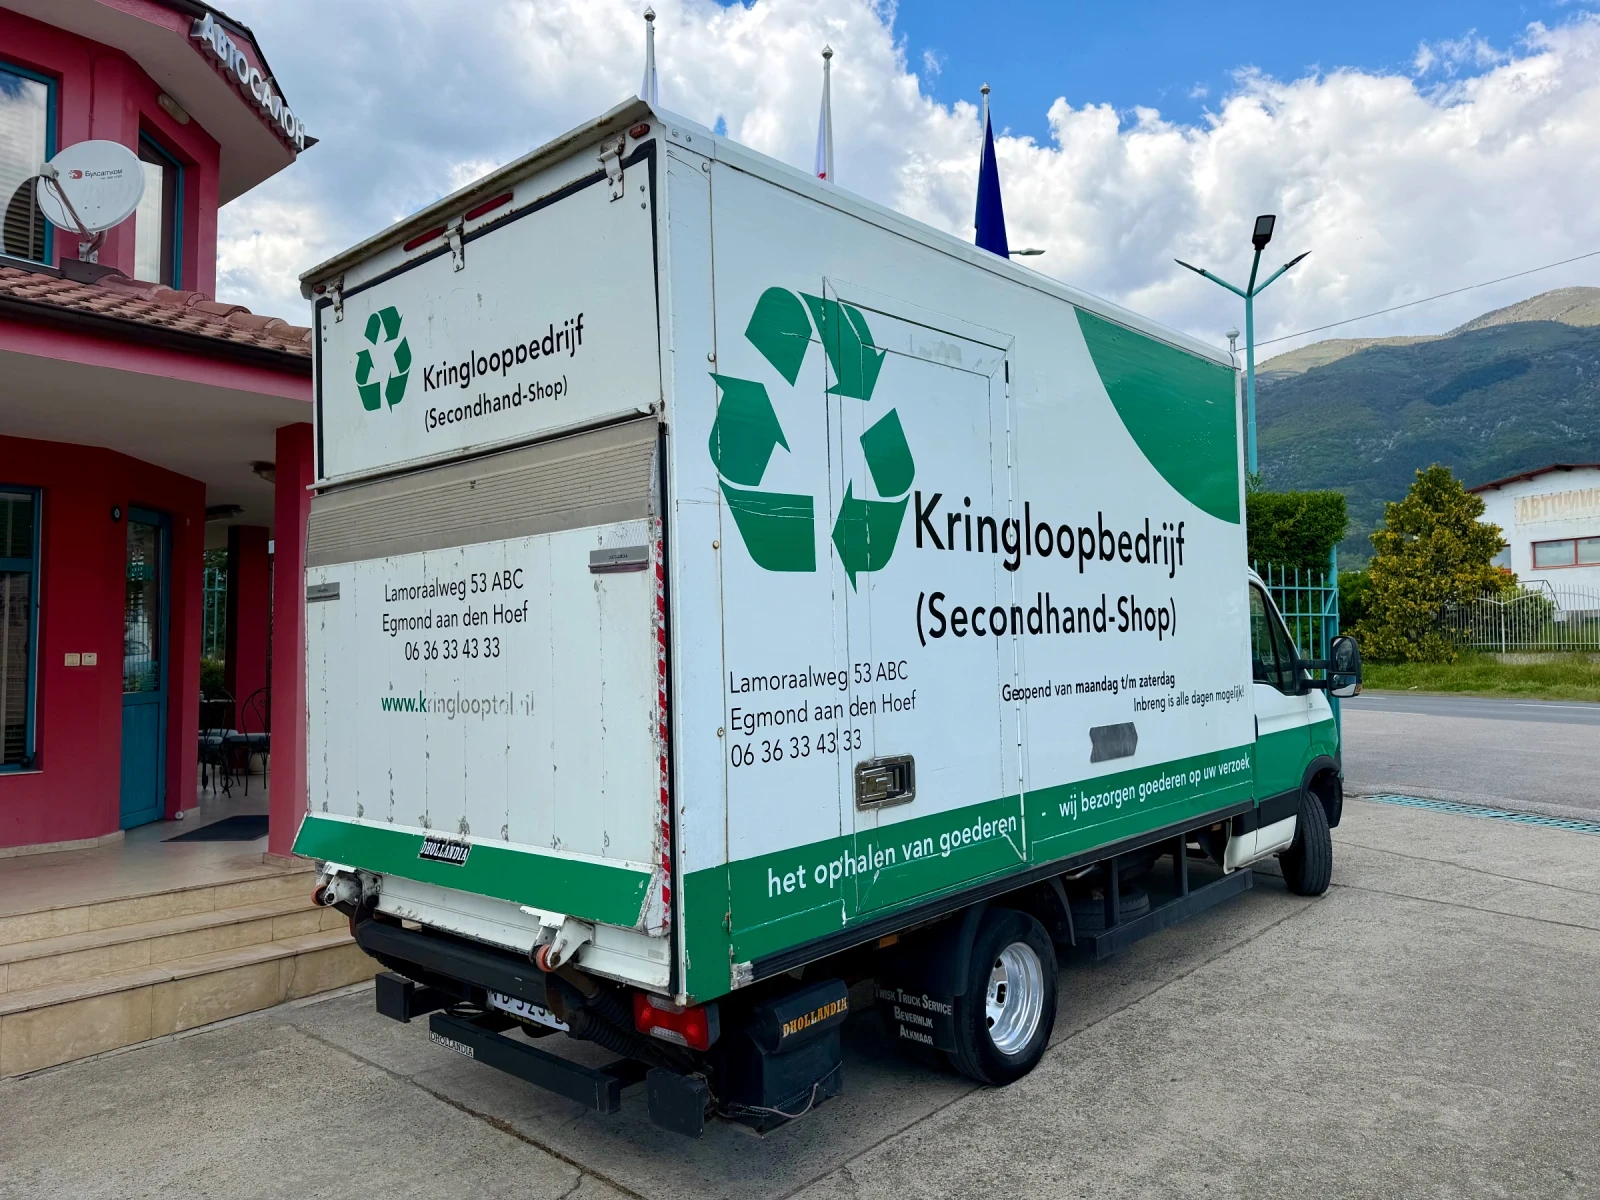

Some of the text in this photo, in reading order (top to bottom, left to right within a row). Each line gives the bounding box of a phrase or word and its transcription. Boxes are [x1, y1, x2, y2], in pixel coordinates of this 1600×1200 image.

[195, 12, 305, 151] АВТОСАЛОН
[423, 312, 584, 392] Kringloopbedrijf
[424, 374, 568, 432] (Secondhand-Shop)
[914, 490, 1185, 579] Kringloopbedrijf
[384, 568, 524, 601] Lamoraalweg 53 ABC
[382, 599, 529, 637] Egmond aan den Hoef
[916, 591, 1176, 647] (Secondhand-Shop)
[404, 636, 500, 661] 06 36 33 43 33
[729, 660, 909, 693] Lamoraalweg 53 ABC
[1002, 670, 1176, 704] Geopend van maandag t/m zaterdag
[730, 688, 917, 736] Egmond aan den Hoef
[1133, 685, 1245, 713] Inbreng is alle dagen mogelijk!
[731, 728, 862, 767] 06 36 33 43 33
[767, 865, 806, 898] het
[814, 843, 896, 888] ophalen
[902, 837, 934, 860] van
[940, 815, 1017, 857] goederen
[1059, 792, 1078, 821] wij
[1081, 785, 1136, 813] bezorgen
[1138, 772, 1187, 803] goederen
[1188, 768, 1201, 788] op
[1203, 764, 1217, 780] uw
[1218, 751, 1251, 775] verzoek
[419, 840, 469, 862] DHOLLANDIA
[782, 996, 849, 1039] DHOLLANDIA
[893, 1005, 934, 1029] BEVERWIJK
[896, 988, 922, 1008] TRUCK
[922, 993, 953, 1017] SERVICE
[430, 1031, 473, 1057] DHOLLANDIA
[899, 1023, 935, 1046] ALKMAAR
